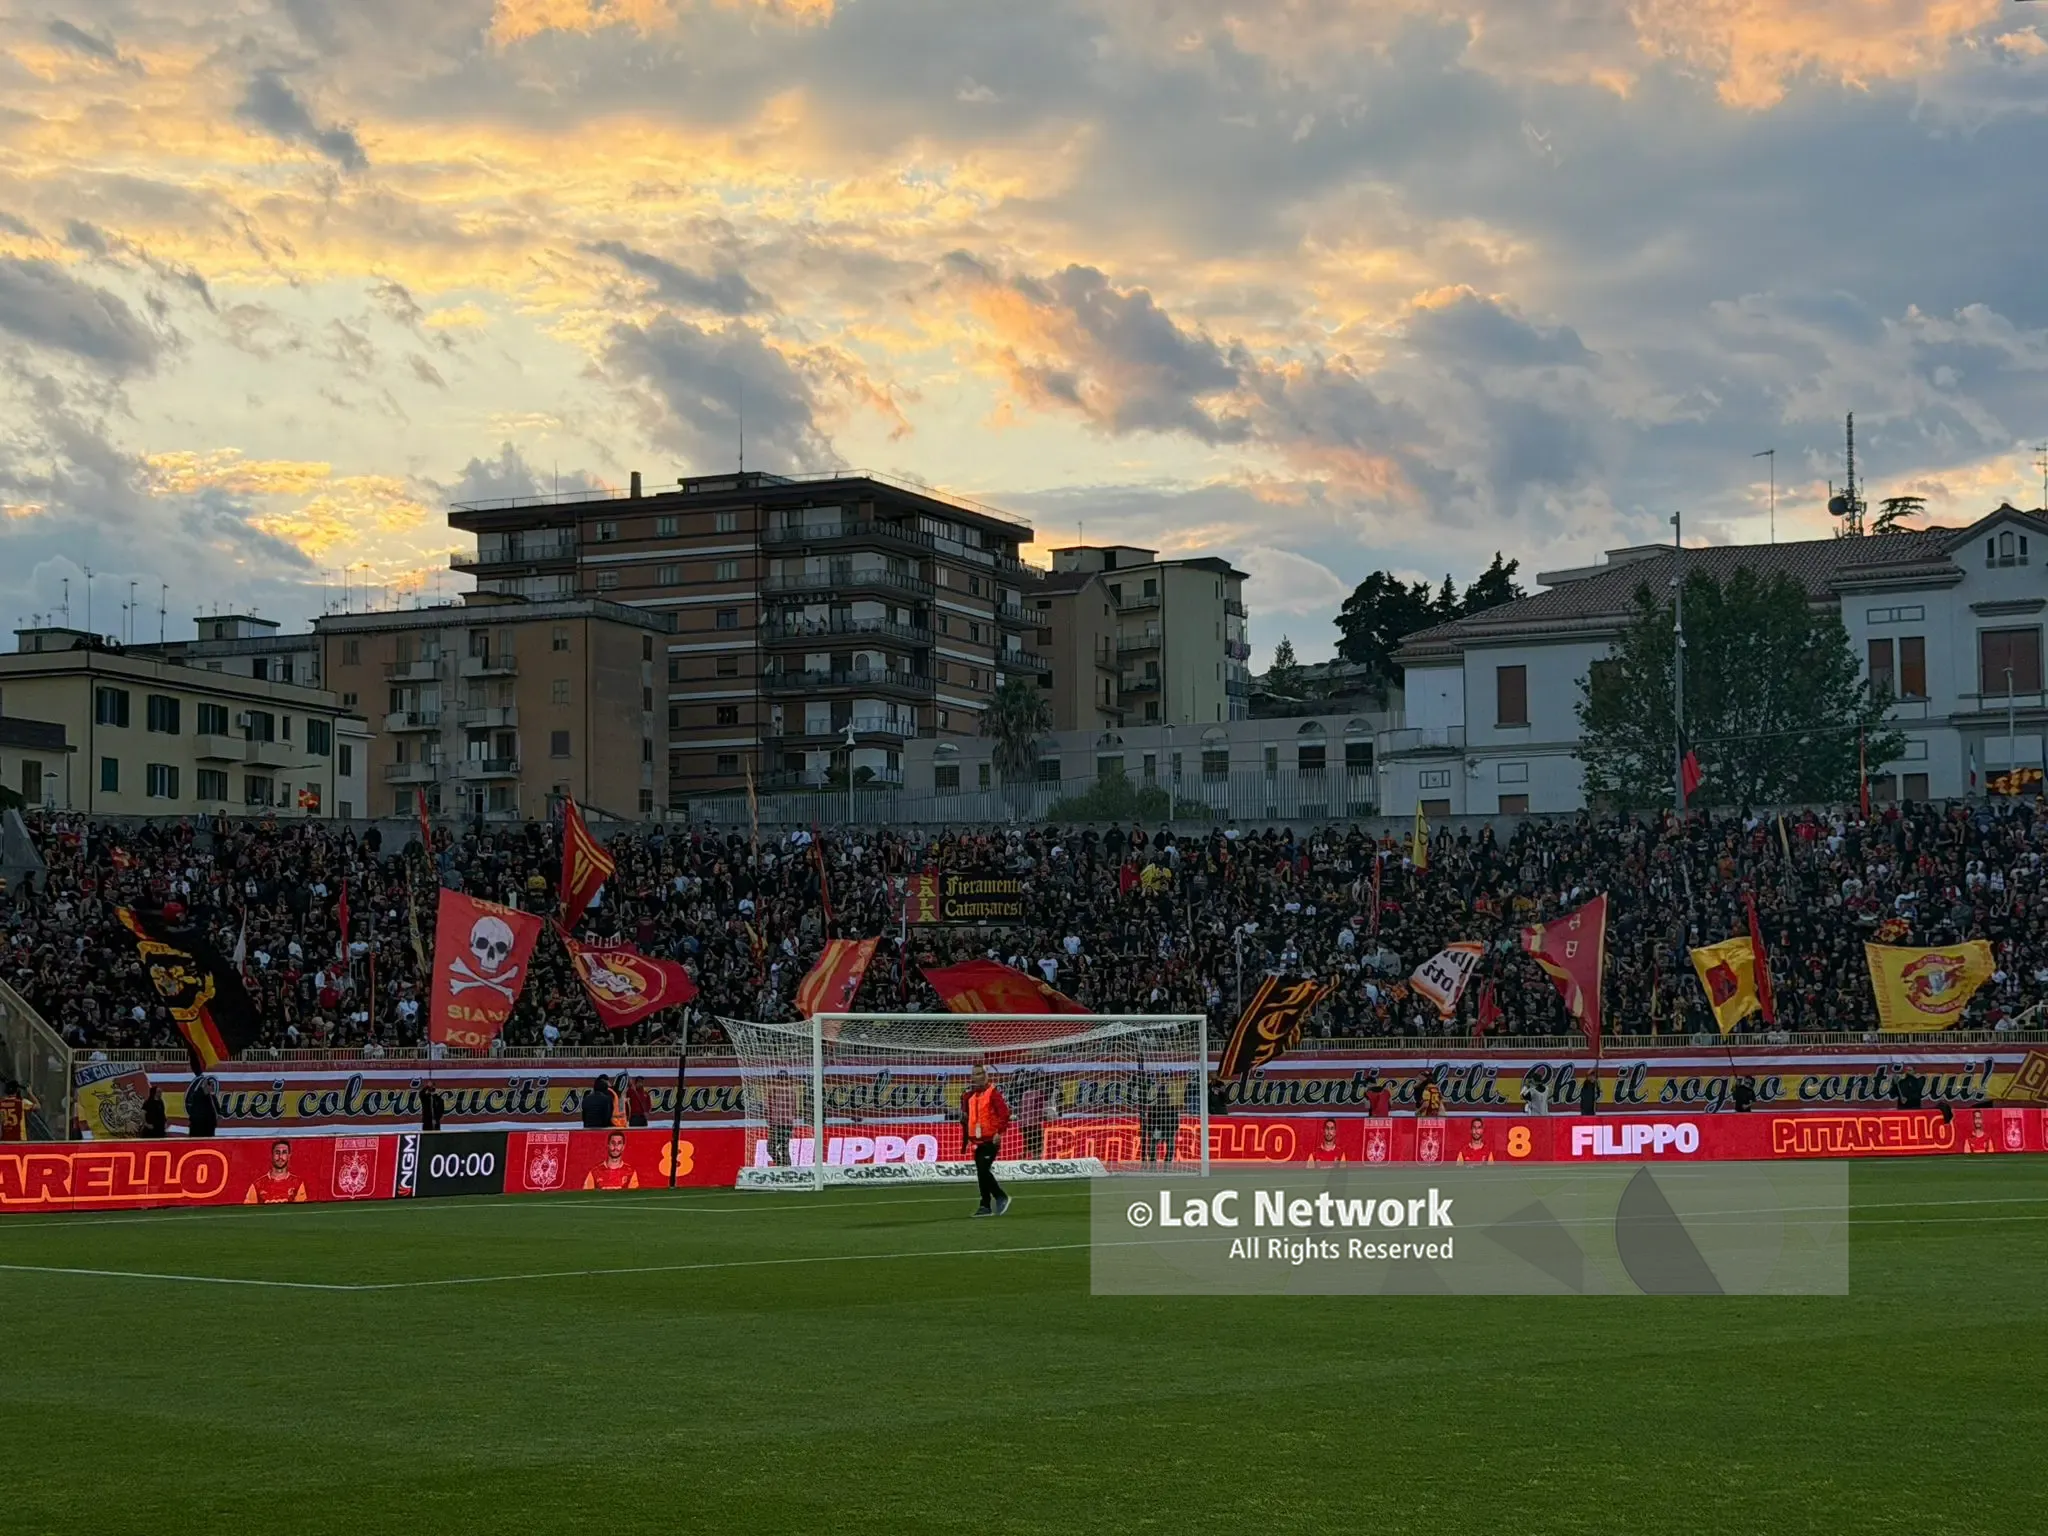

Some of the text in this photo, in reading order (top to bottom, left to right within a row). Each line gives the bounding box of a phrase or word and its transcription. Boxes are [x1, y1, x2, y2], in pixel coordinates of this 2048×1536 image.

[296, 1073, 422, 1119] colori
[440, 1075, 549, 1116] cuciti
[1613, 1061, 1648, 1104] il
[1658, 1073, 1786, 1114] sogo
[1507, 1122, 1700, 1158] 8 FILIPPO
[1772, 1116, 1955, 1153] PITTARELLO
[400, 1134, 417, 1189] NGM
[429, 1152, 495, 1178] 00:00
[658, 1140, 694, 1177] 8
